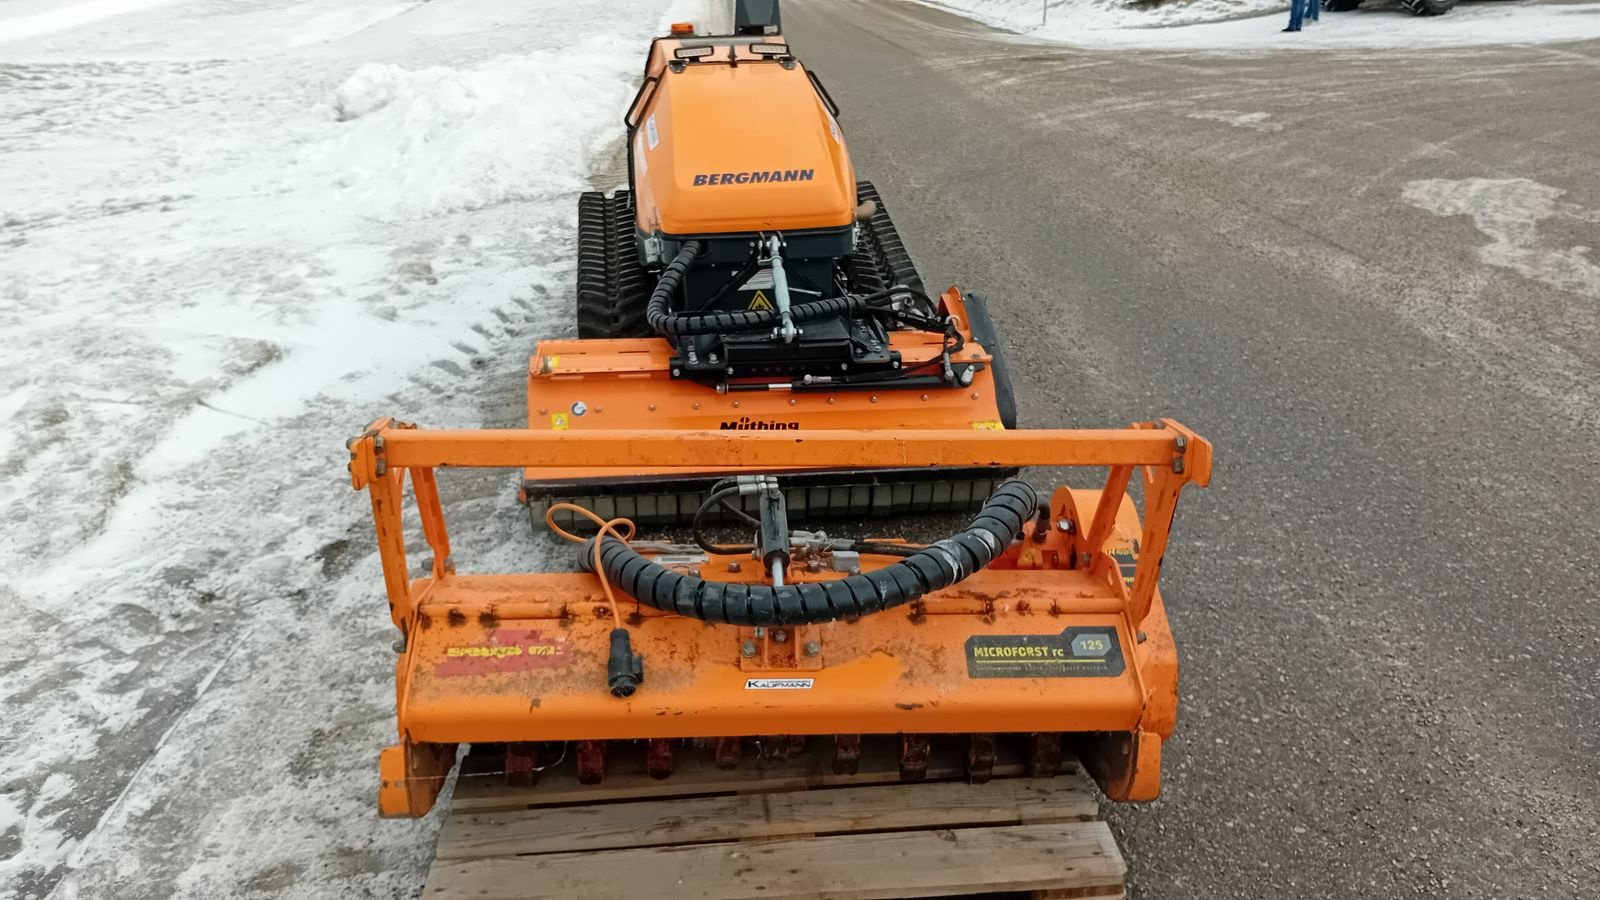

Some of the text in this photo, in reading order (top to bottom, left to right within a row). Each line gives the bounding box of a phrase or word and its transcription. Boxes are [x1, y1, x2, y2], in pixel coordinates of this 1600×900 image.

[693, 169, 814, 186] BERGMANN
[1080, 639, 1104, 650] 125
[1052, 648, 1064, 657] rc
[747, 680, 811, 688] KAUFMANN
